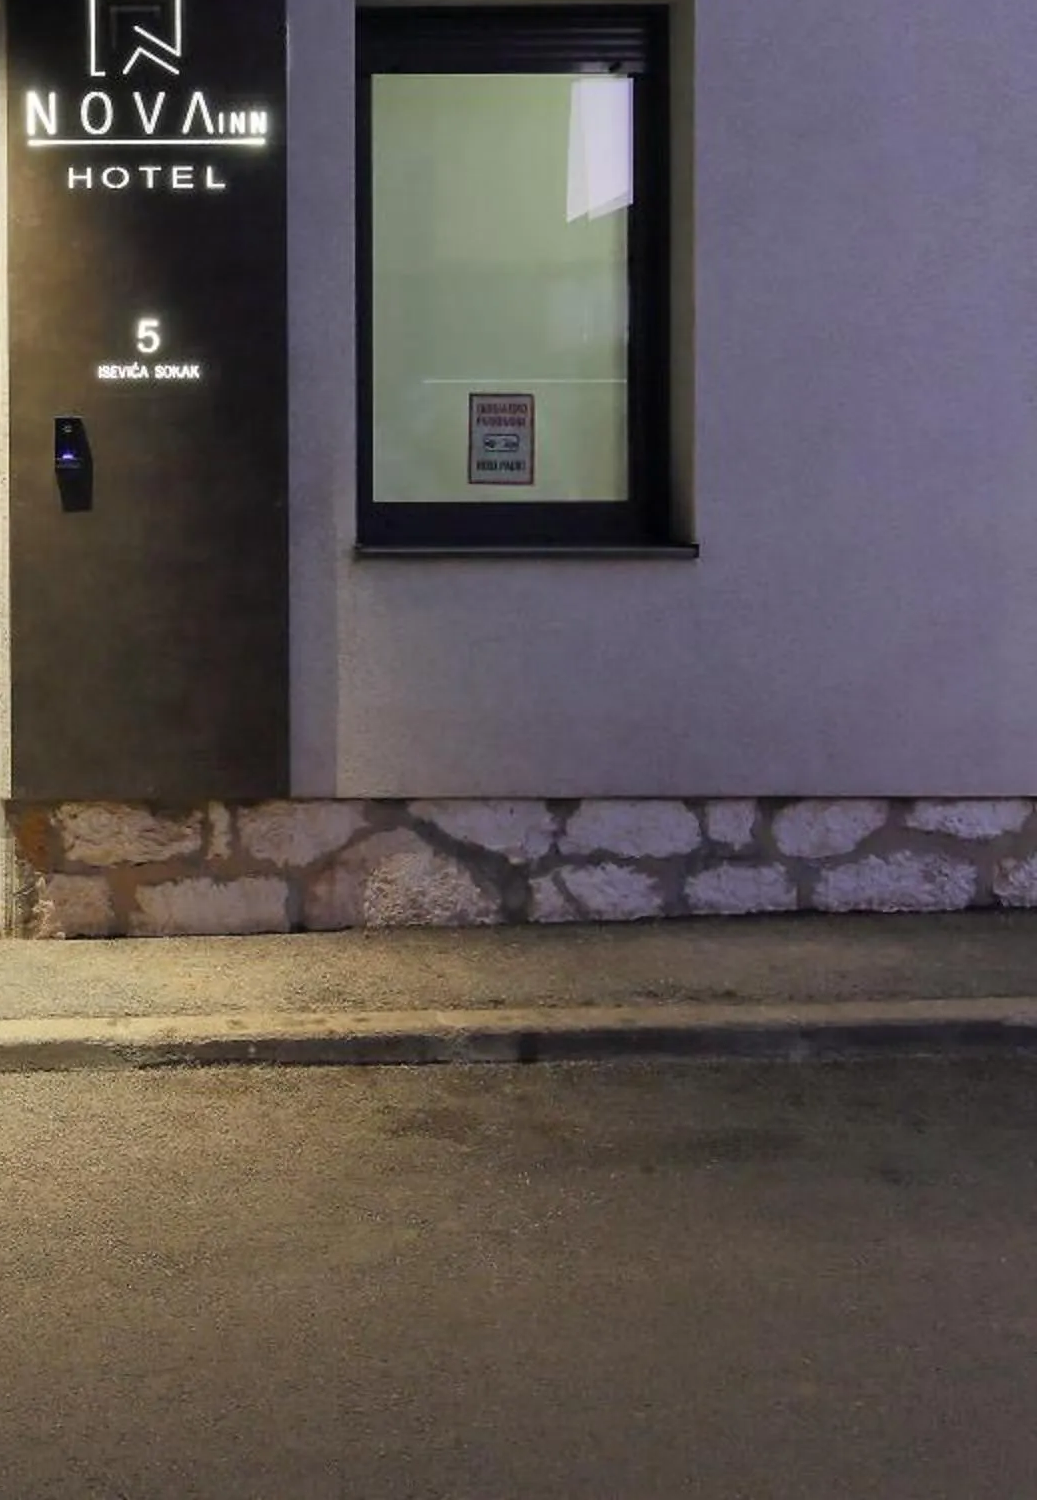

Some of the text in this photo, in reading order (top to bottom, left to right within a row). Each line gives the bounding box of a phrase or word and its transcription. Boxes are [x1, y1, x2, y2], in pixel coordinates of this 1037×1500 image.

[25, 91, 267, 135] NOVA INN
[68, 166, 226, 189] HOTEL
[137, 318, 161, 353] 5
[154, 365, 200, 379] SOKAK
